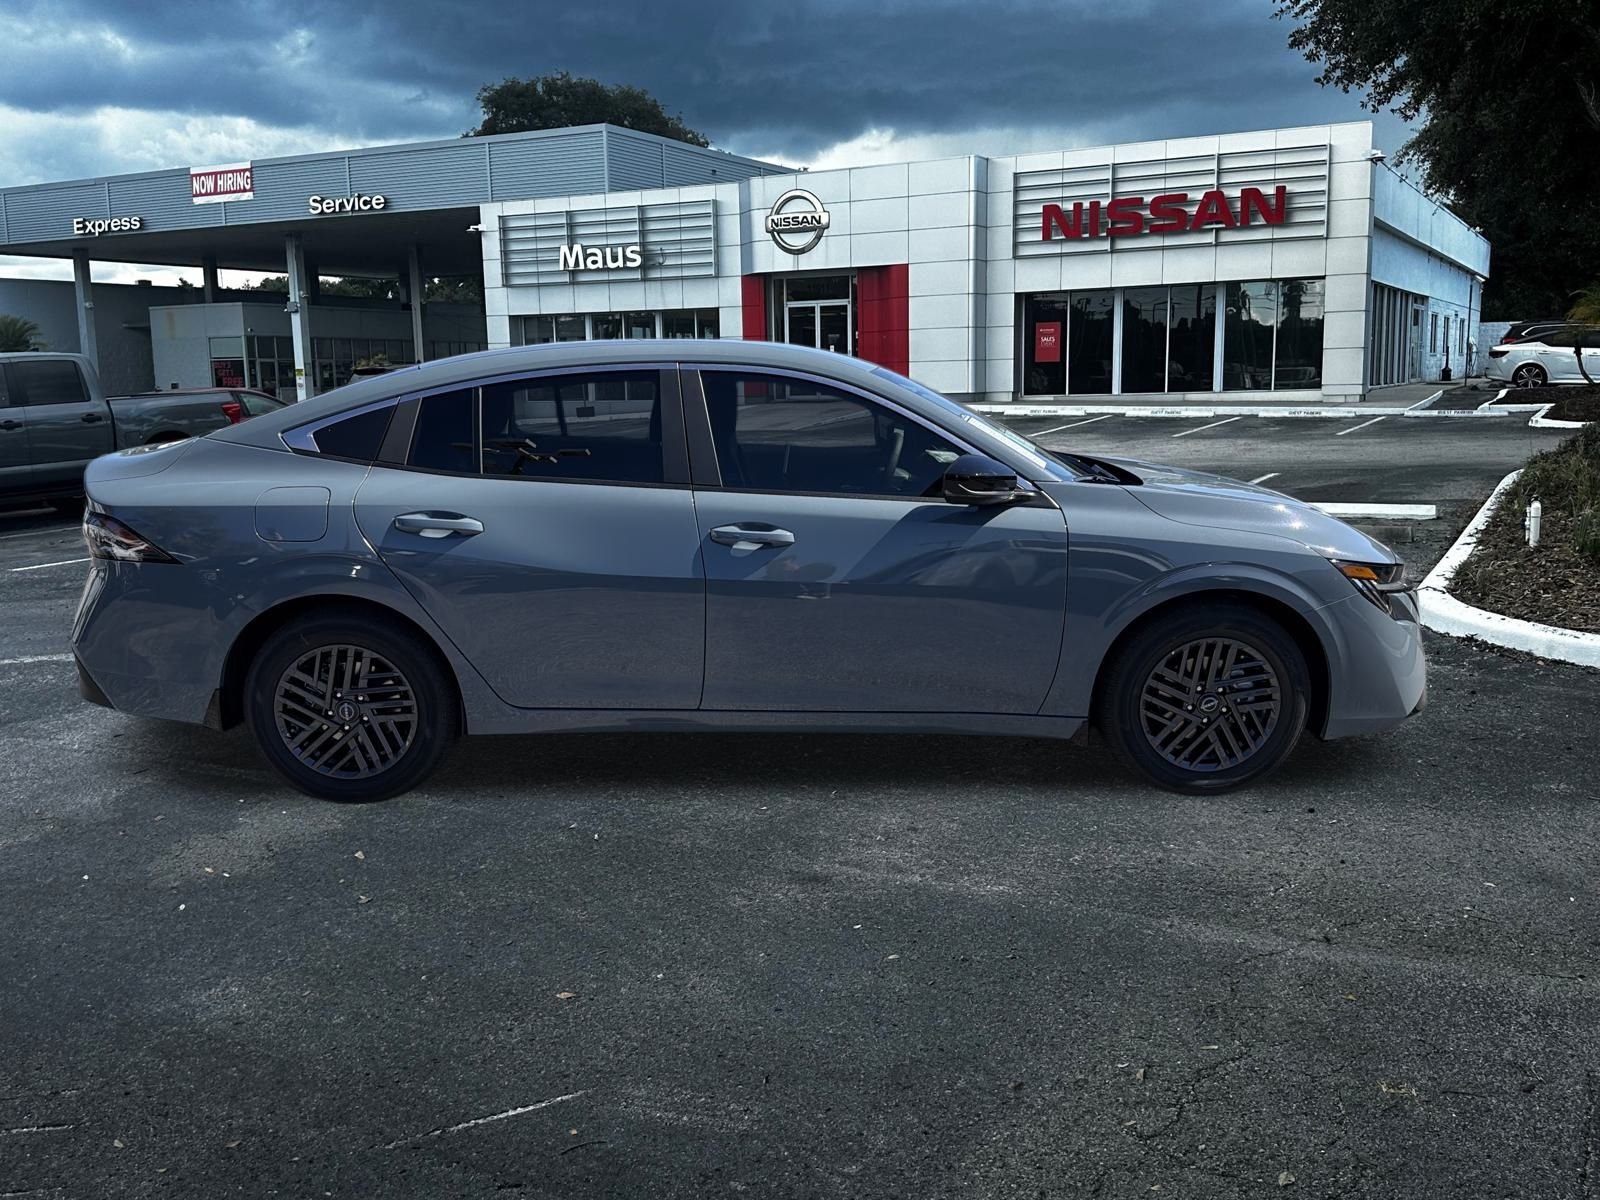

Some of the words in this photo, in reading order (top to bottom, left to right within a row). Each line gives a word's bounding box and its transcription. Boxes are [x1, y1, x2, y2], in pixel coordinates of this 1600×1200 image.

[192, 174, 215, 195] NOW
[217, 171, 251, 193] HIRING
[308, 192, 385, 215] Service
[1042, 185, 1287, 241] NISSAN
[73, 216, 141, 237] Express
[770, 214, 822, 228] NISSAN
[559, 243, 642, 271] Maus
